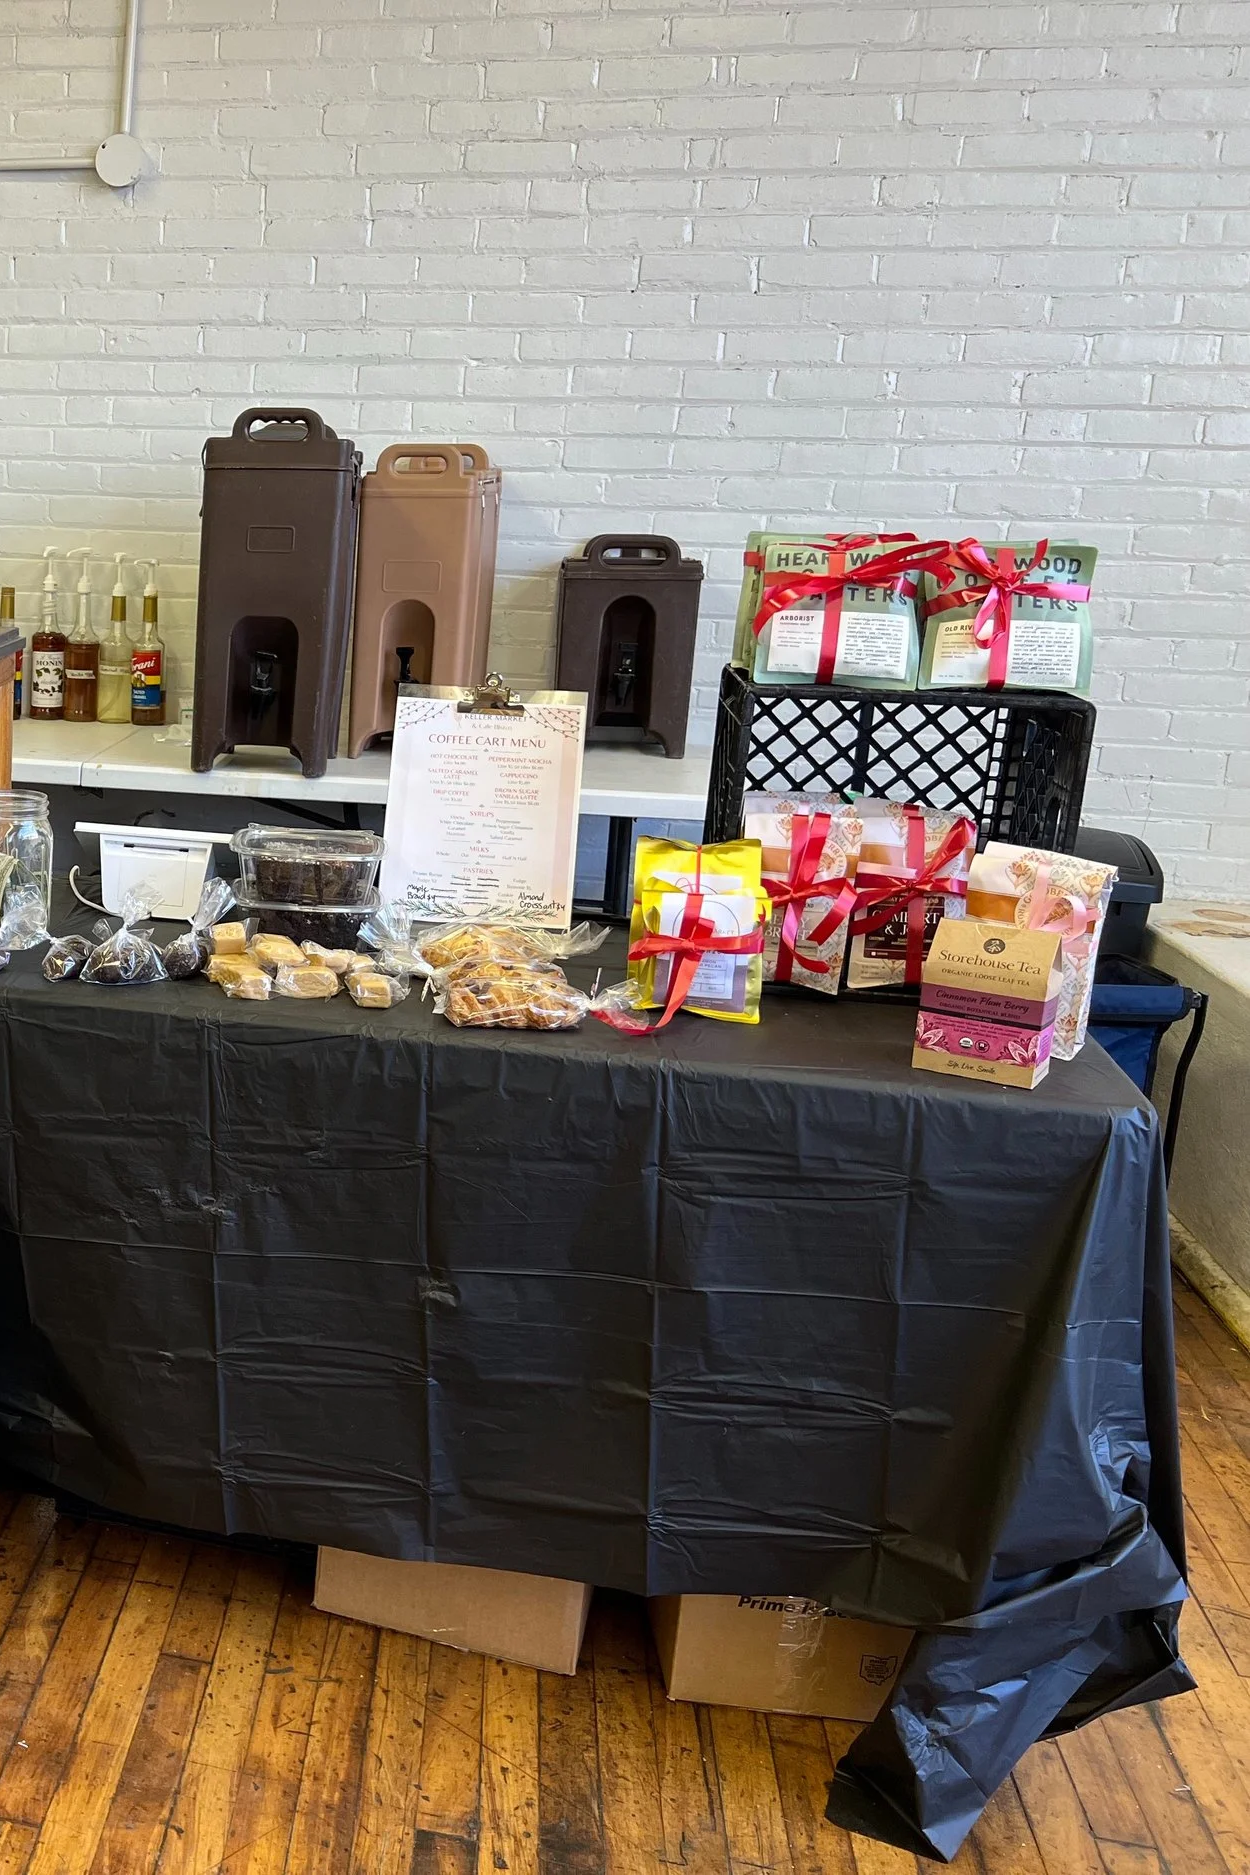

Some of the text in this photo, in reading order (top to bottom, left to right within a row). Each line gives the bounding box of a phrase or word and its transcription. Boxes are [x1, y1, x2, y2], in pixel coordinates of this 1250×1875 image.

[429, 734, 547, 748] COFFEE CART MENU
[463, 867, 494, 875] PASTRIES
[518, 892, 545, 901] Almond
[519, 900, 557, 910] Croissant
[884, 924, 895, 936] &
[938, 949, 1041, 975] Storehouse Tea
[941, 968, 1030, 987] ORGANIC LOOSE LEAF TEA
[936, 989, 1030, 1015] Cinnamon Plum Berry
[939, 1001, 965, 1011] ORGANIC
[966, 1006, 999, 1017] BOTANICAL
[737, 1595, 796, 1613] Prime
